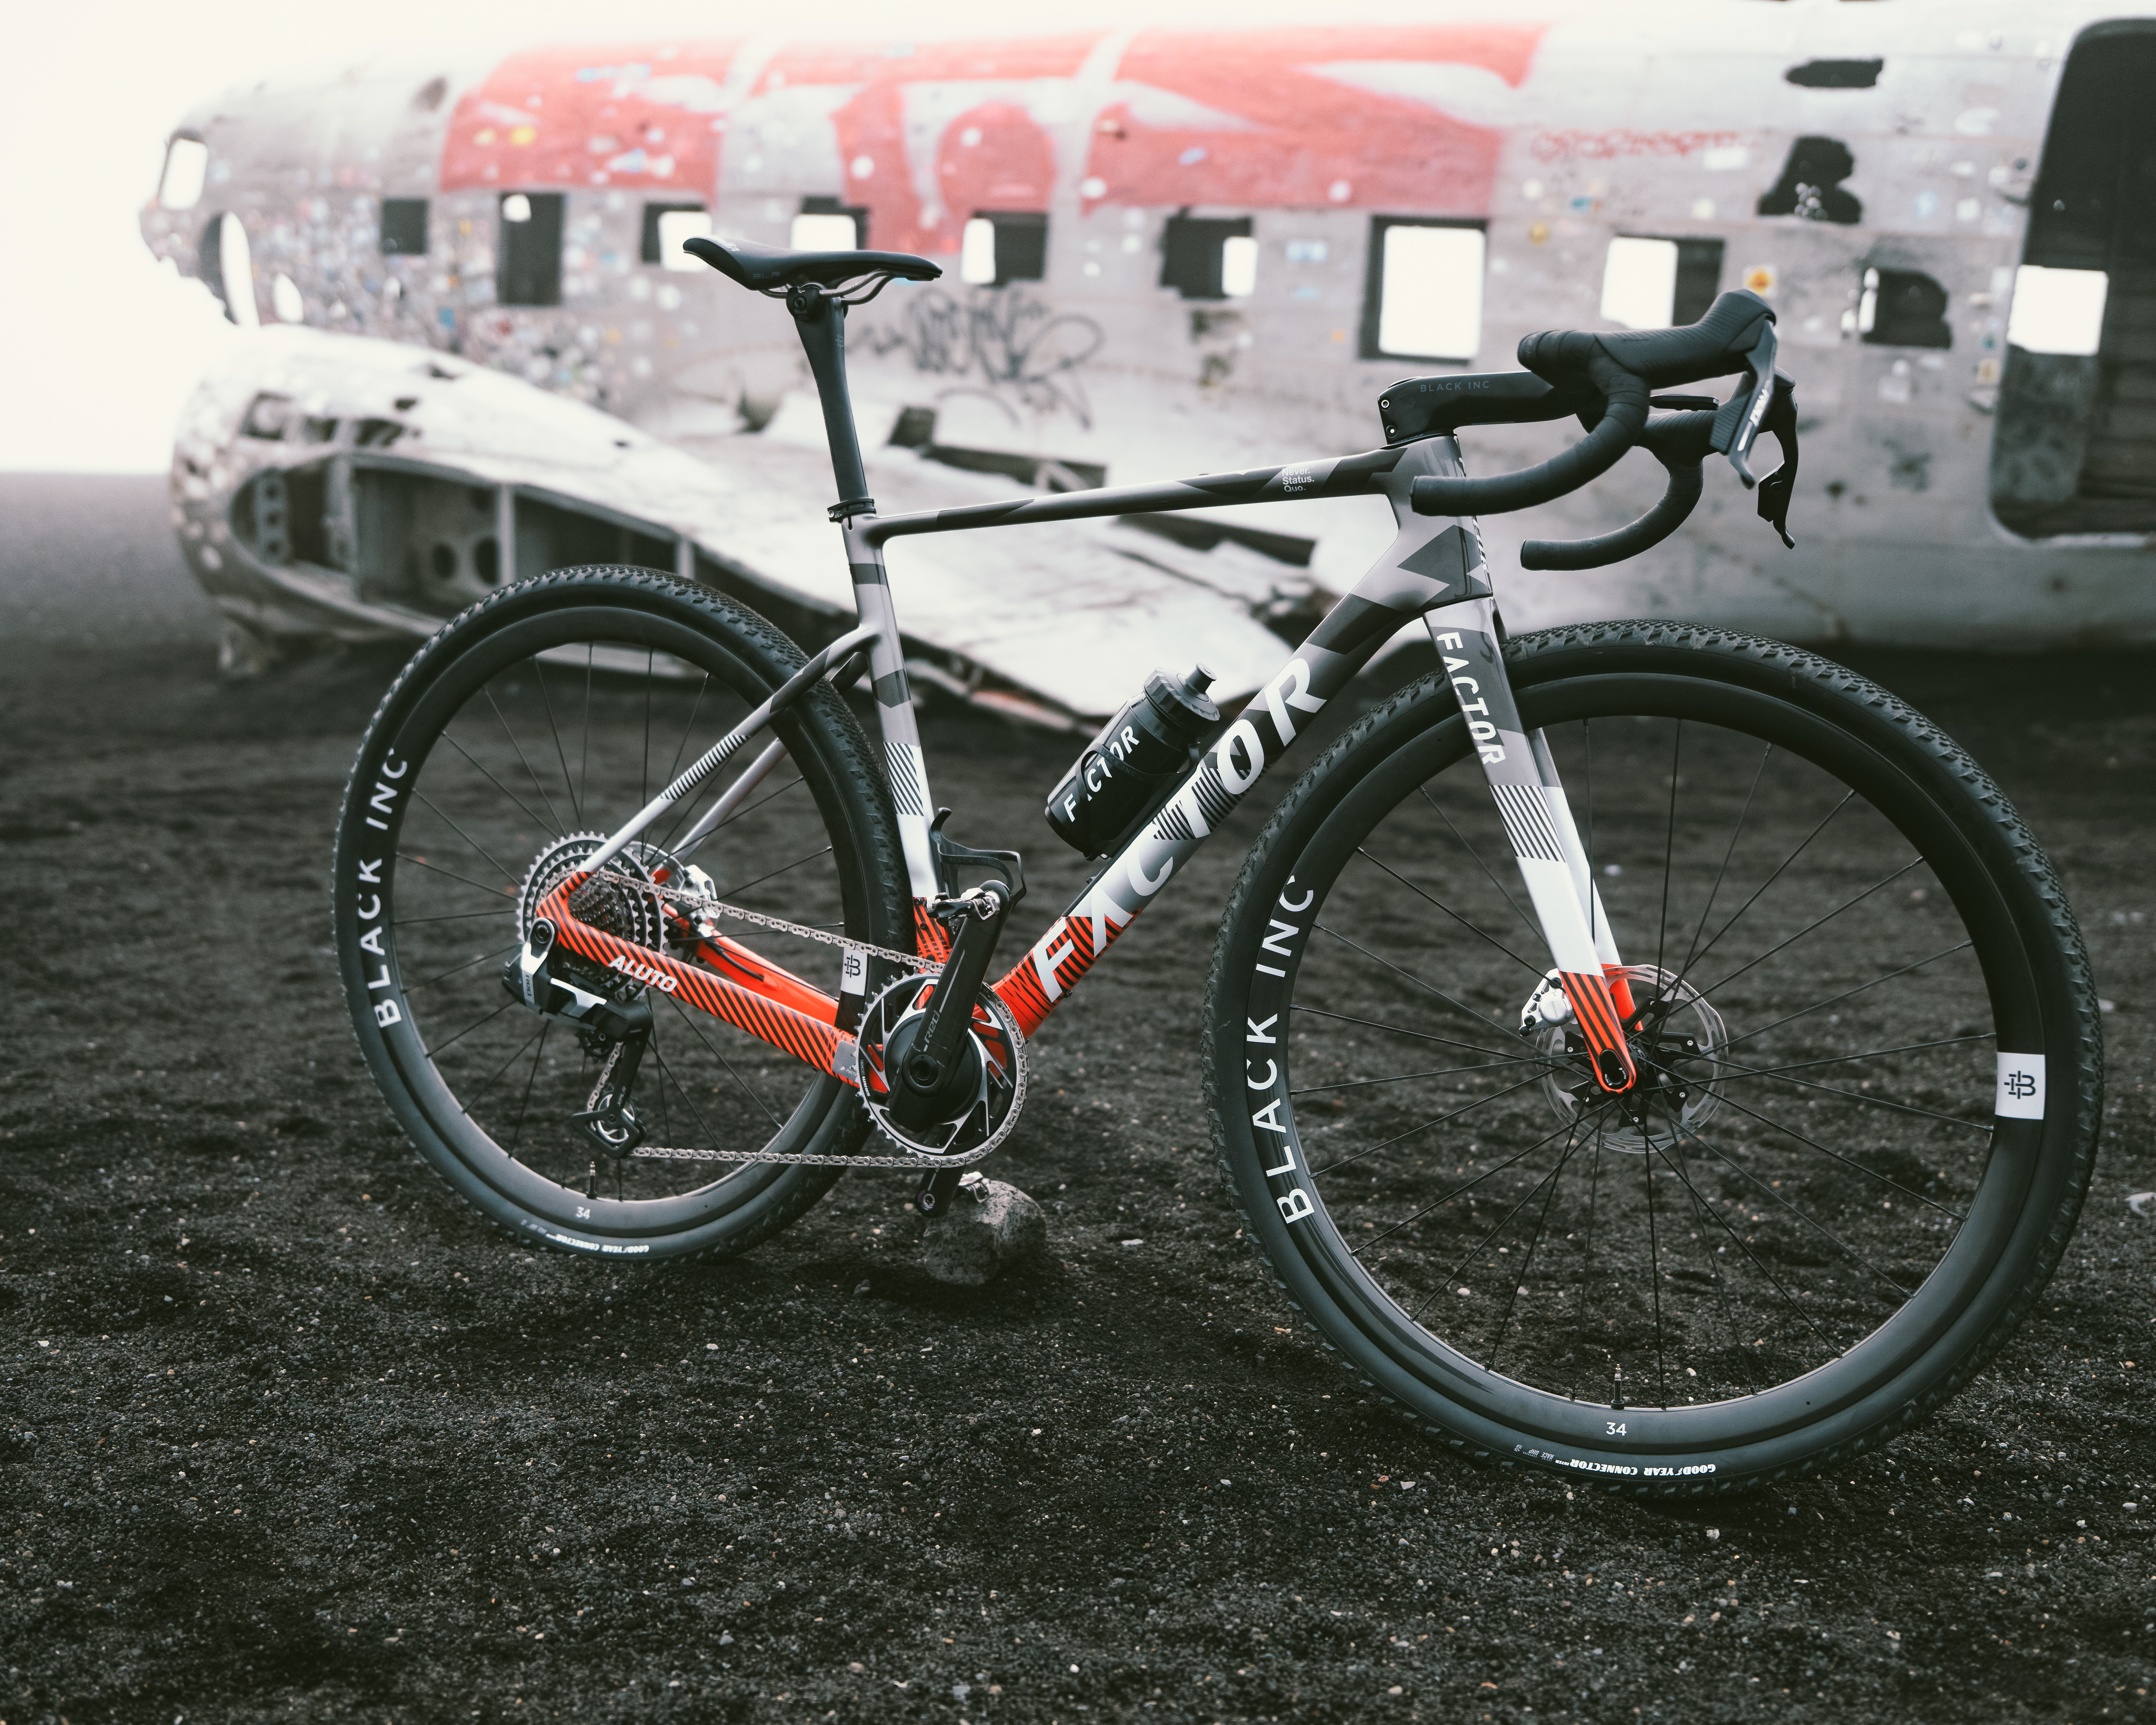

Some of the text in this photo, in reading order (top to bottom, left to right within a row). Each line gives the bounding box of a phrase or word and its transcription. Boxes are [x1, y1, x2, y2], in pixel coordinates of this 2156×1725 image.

[1420, 381, 1490, 392] BLACK INC
[1282, 467, 1310, 476] Never.
[1282, 476, 1315, 485] Status.
[1437, 632, 1506, 765] FACTOR
[1099, 747, 1137, 777] BLACK INC
[1063, 726, 1140, 822] FCTOR
[1032, 658, 1327, 1003] FACTOR
[357, 748, 408, 1028] BLACK INC
[608, 955, 678, 992] ALUTO
[1246, 875, 1315, 1224] BLACK INC
[862, 1076, 871, 1097] SRAM
[576, 1206, 591, 1220] 34
[555, 1233, 600, 1251] CONNECTOR
[1606, 1421, 1627, 1436] 34
[1540, 1451, 1555, 1460] RACE
[1570, 1458, 1638, 1475] CONNECTOR
